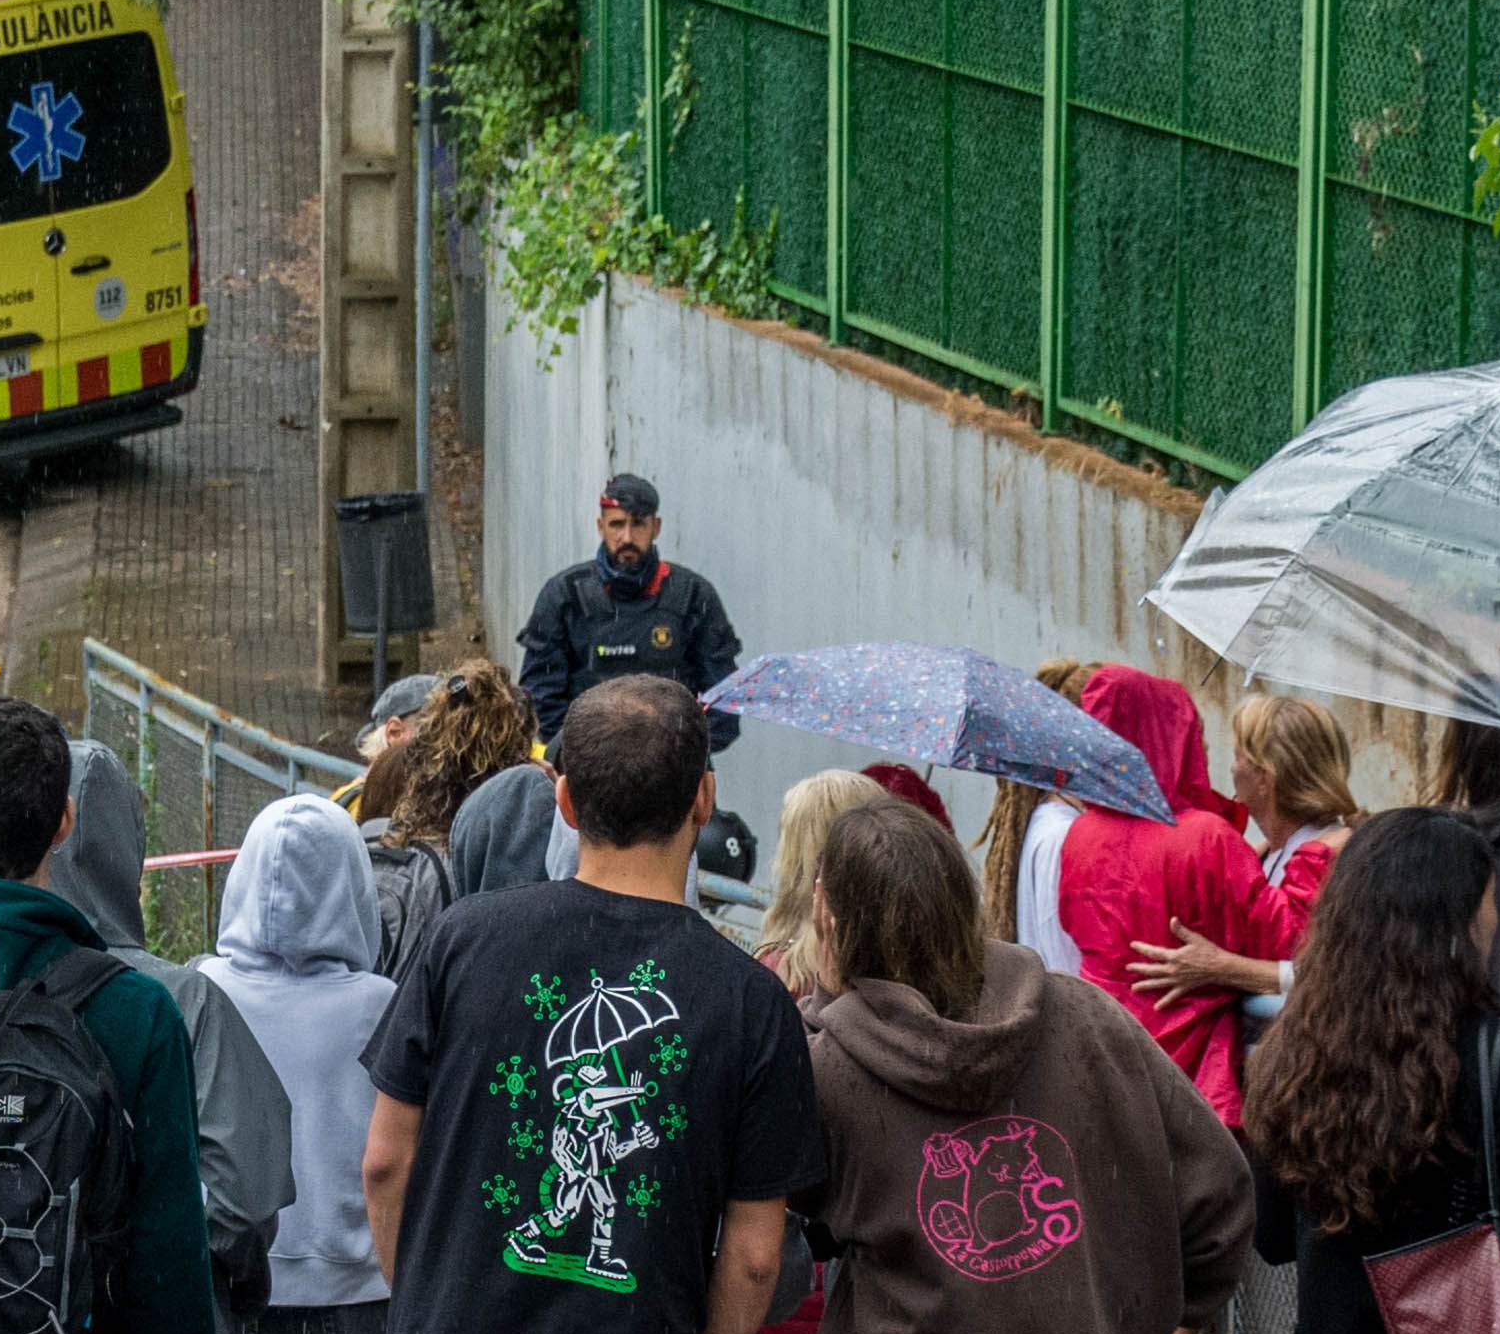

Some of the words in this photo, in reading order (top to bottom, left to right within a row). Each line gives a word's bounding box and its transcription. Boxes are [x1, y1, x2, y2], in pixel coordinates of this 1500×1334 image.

[99, 286, 122, 306] 112
[145, 285, 183, 314] 8751
[725, 837, 740, 858] 8
